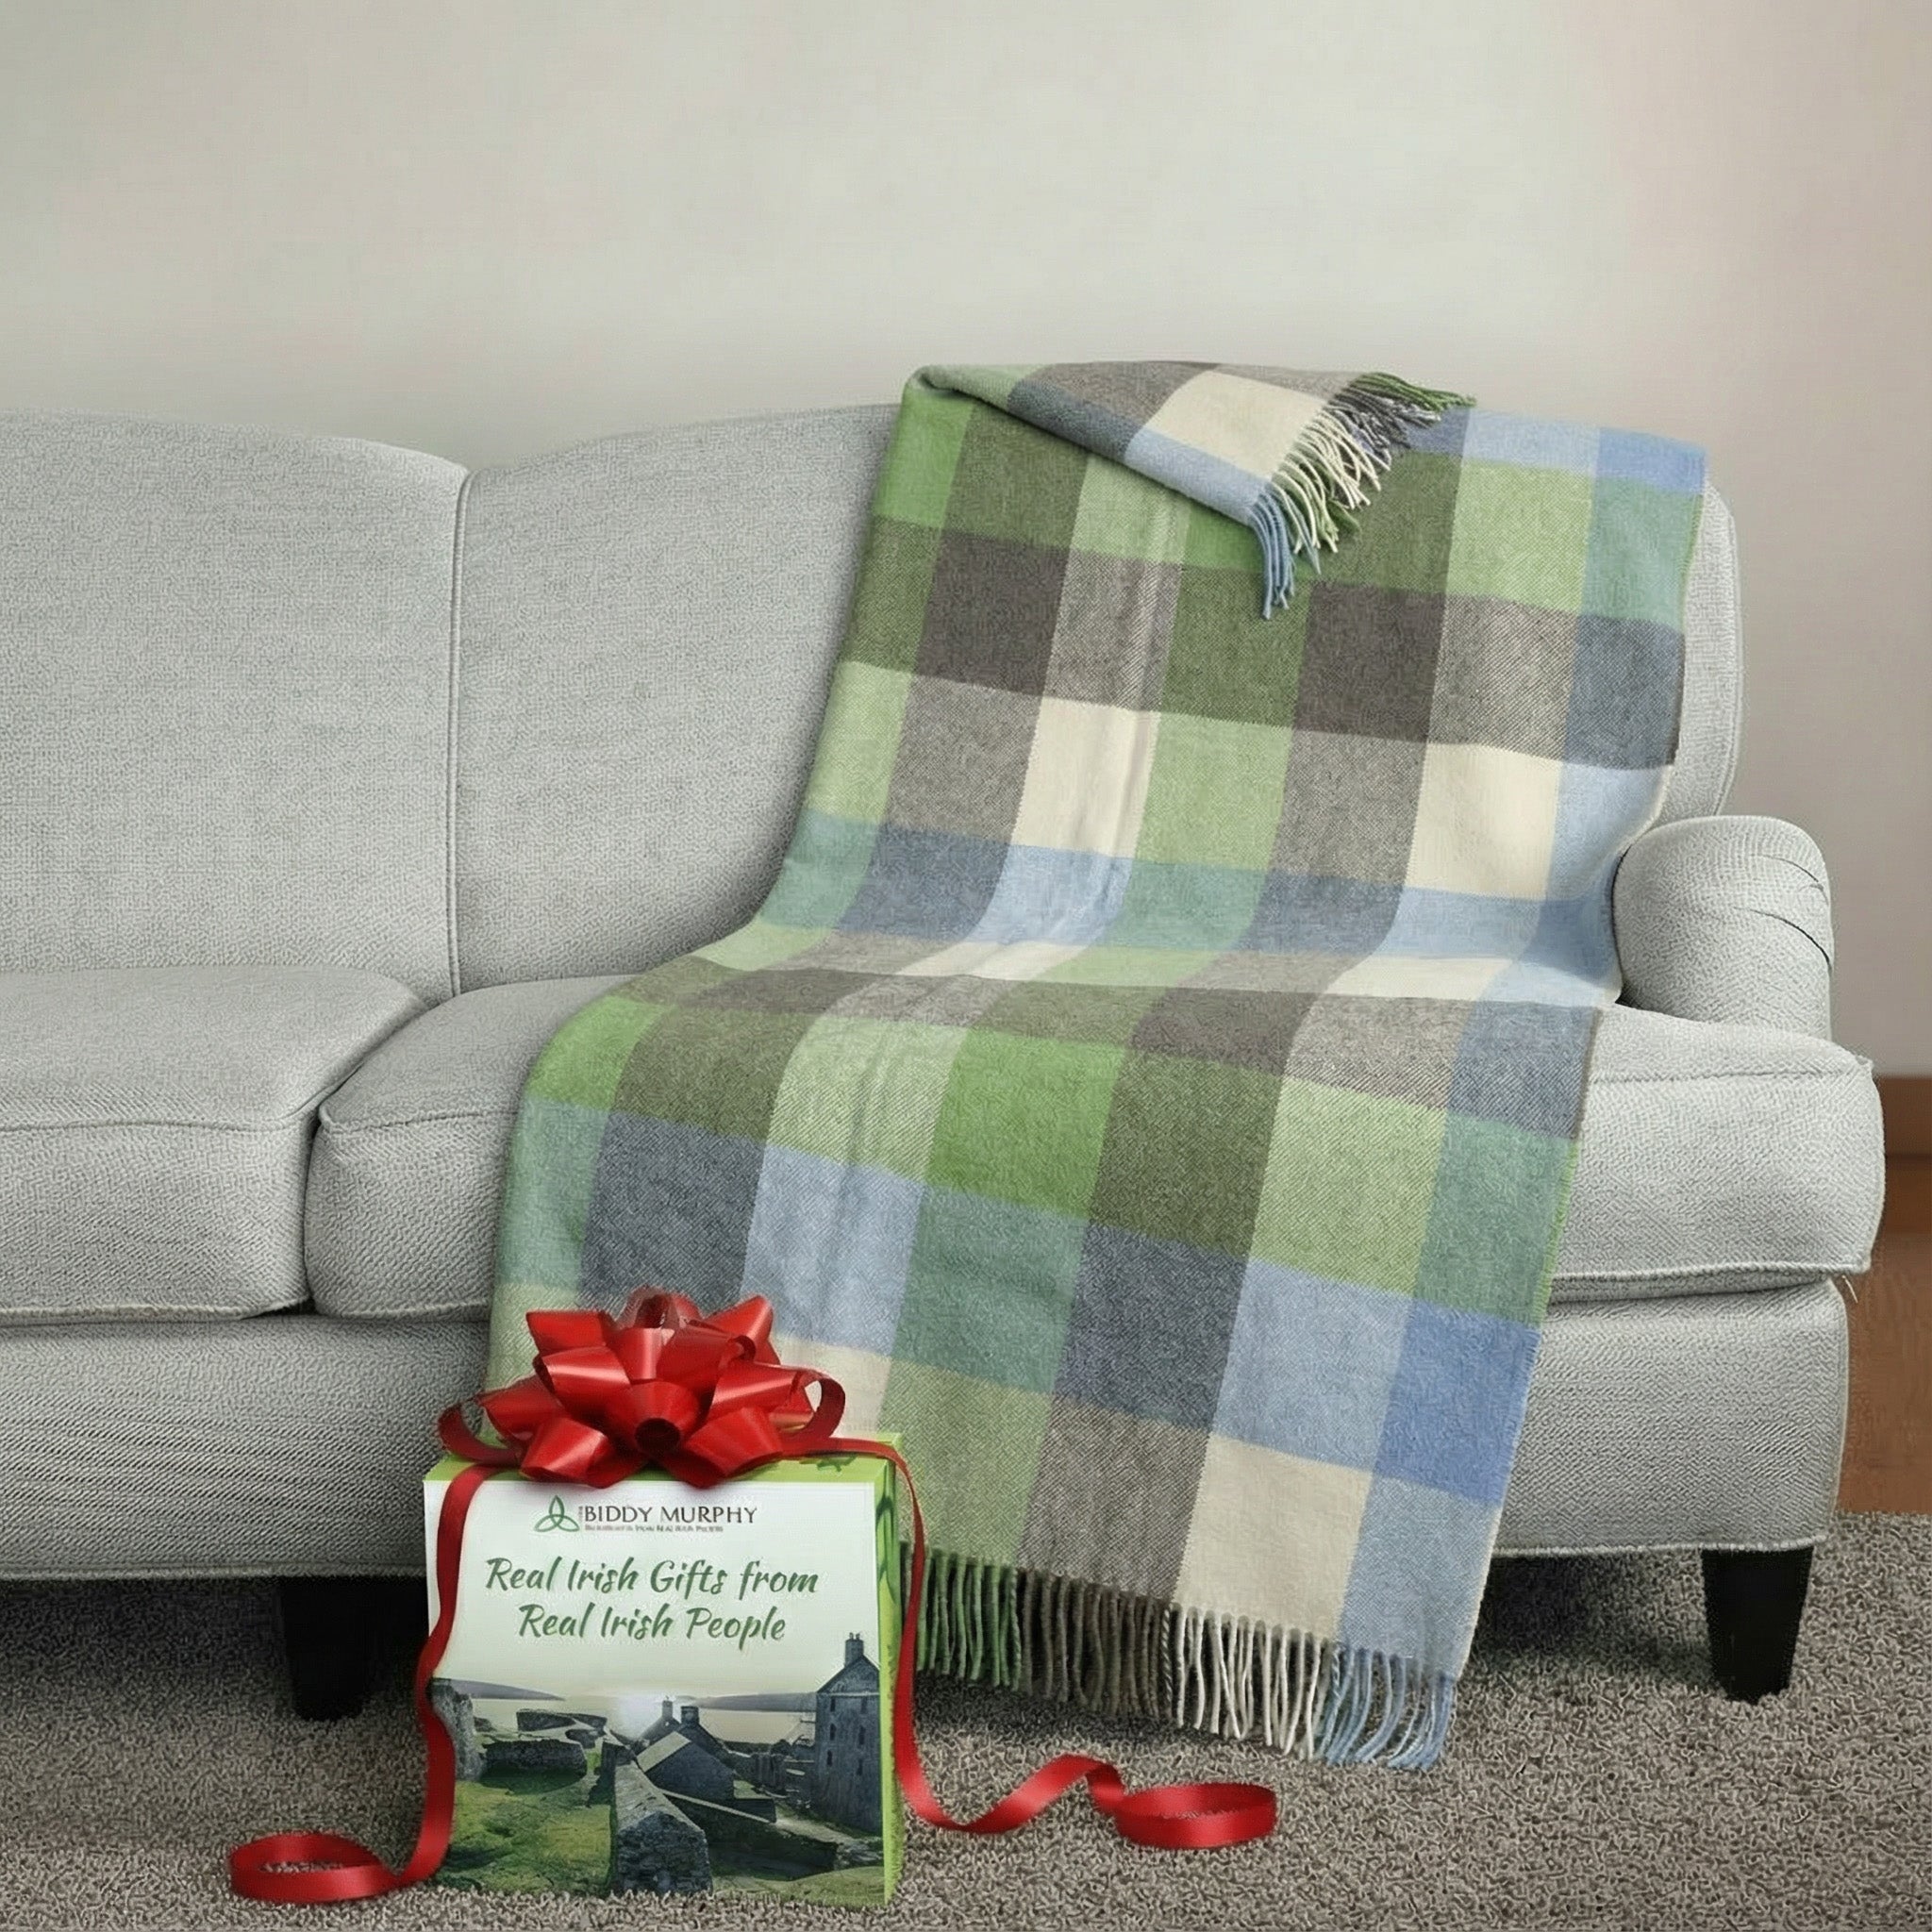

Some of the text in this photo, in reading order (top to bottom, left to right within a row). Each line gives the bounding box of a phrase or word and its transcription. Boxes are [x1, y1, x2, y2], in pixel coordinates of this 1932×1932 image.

[584, 1506, 653, 1524] BIDDY
[660, 1506, 758, 1524] MURPHY
[485, 1557, 818, 1601] Real Irish Gifts from
[518, 1602, 786, 1651] Real Irish People
